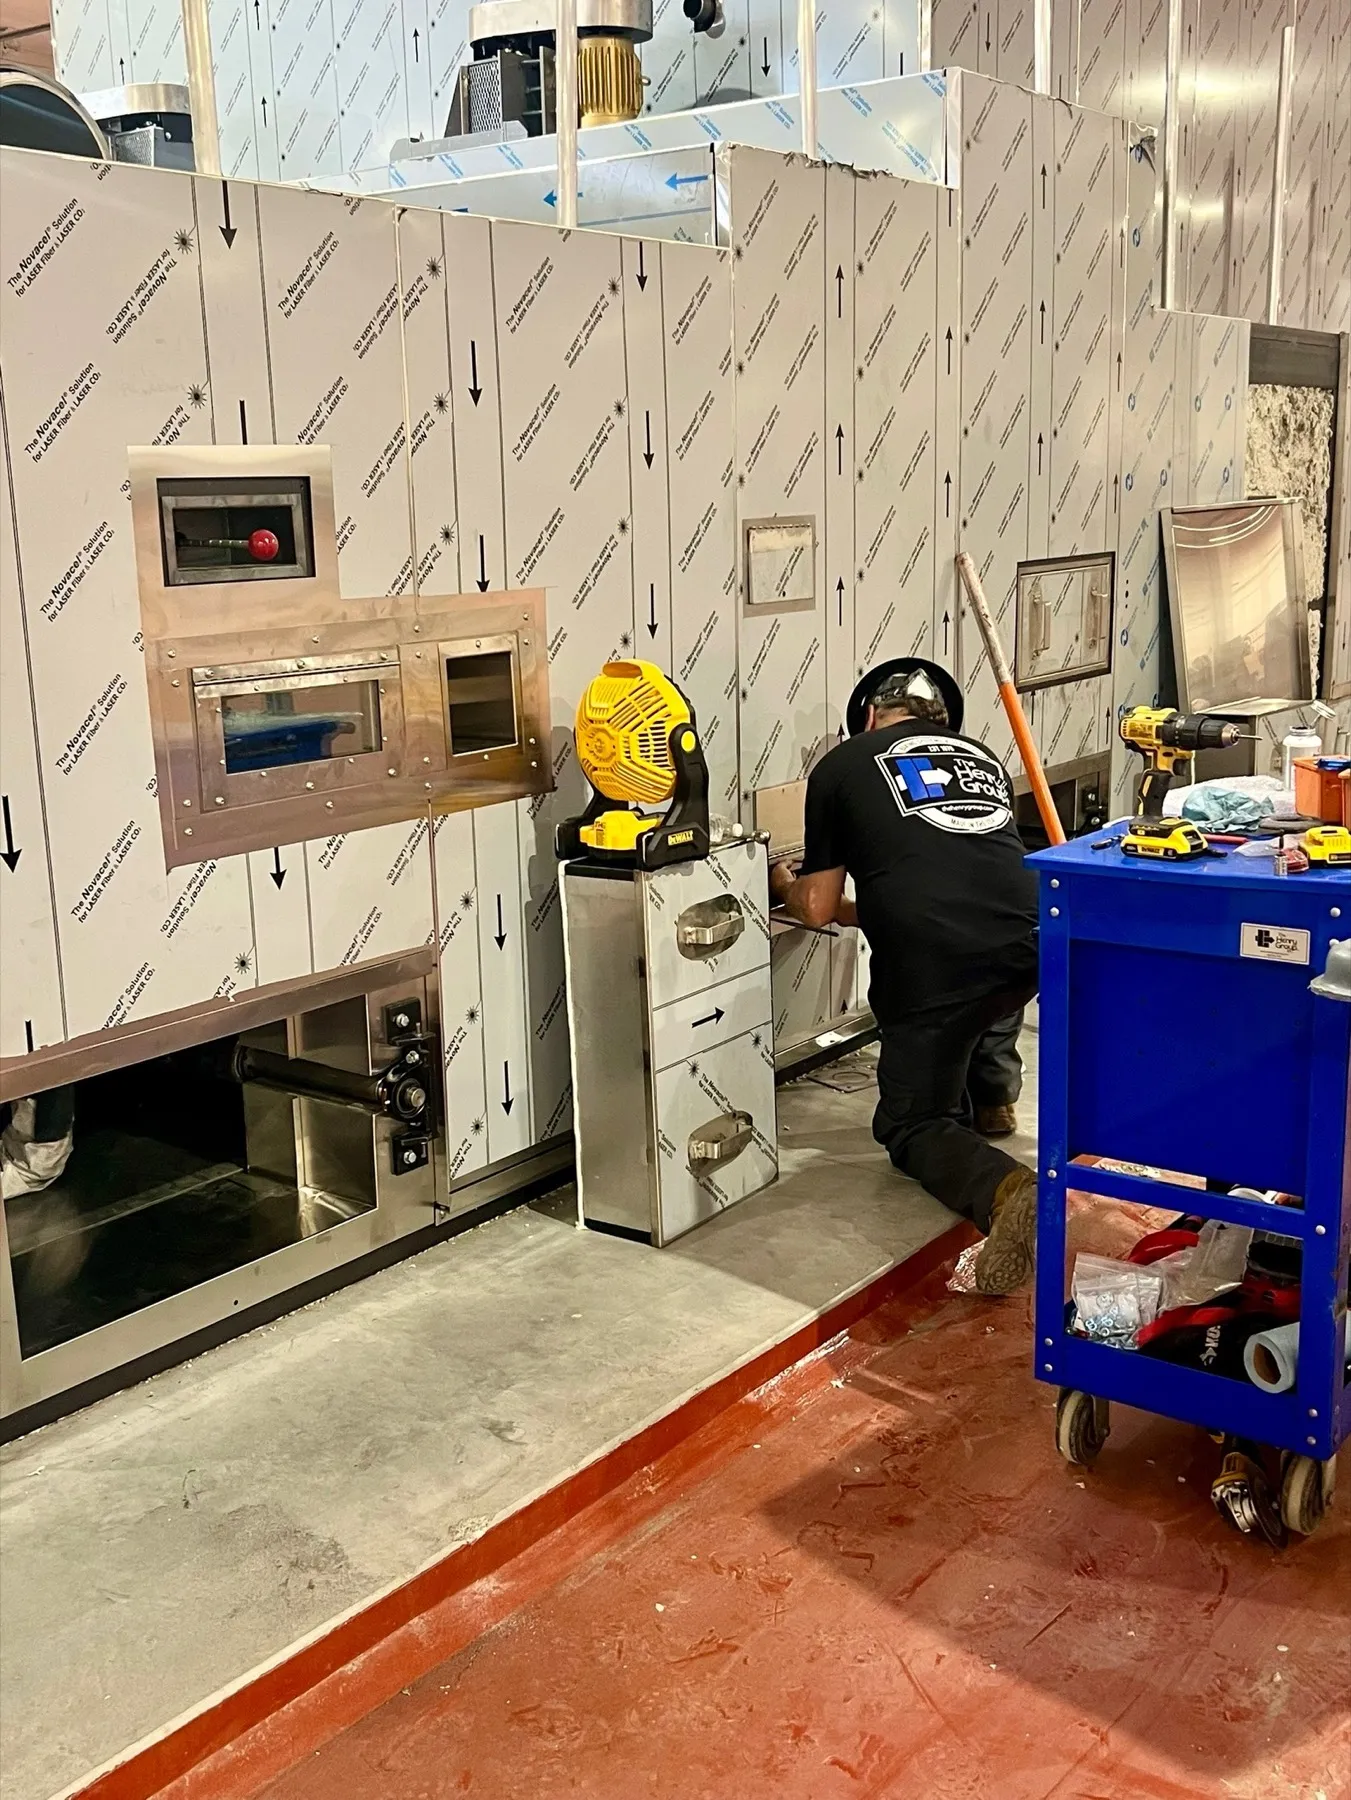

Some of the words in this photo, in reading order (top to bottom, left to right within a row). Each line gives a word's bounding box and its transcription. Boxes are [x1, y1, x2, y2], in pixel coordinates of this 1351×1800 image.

[7, 272, 22, 287] The
[51, 198, 78, 230] Solution
[161, 248, 170, 260] for
[15, 284, 25, 297] for
[23, 262, 43, 287] LASER
[40, 245, 55, 265] Fiber
[56, 219, 75, 243] LASER
[145, 258, 163, 281] LASER
[164, 257, 178, 272] The
[277, 296, 289, 310] The
[313, 231, 333, 259] Solution
[134, 279, 148, 297] Fiber
[283, 307, 292, 319] for
[290, 288, 306, 309] LASER
[303, 273, 315, 290] Fiber
[316, 250, 331, 271] LASER
[115, 300, 133, 323] LASER
[113, 313, 137, 343] Solution
[323, 376, 343, 404] Solution
[24, 438, 39, 453] The
[68, 362, 94, 394] Solution
[174, 404, 183, 416] for
[177, 413, 190, 427] The
[313, 418, 325, 435] Fiber
[326, 394, 341, 415] LASER
[32, 450, 42, 462] for
[39, 427, 59, 452] LASER
[56, 410, 71, 429] Fiber
[72, 383, 91, 407] LASER
[159, 414, 177, 437] LASER
[336, 515, 352, 540] olution
[39, 598, 54, 613] The
[82, 521, 107, 553] Solution
[47, 609, 57, 622] for
[54, 587, 74, 611] LASER
[71, 568, 86, 588] Fiber
[87, 541, 105, 565] LASER
[55, 752, 69, 767] The
[97, 673, 121, 706] Solution
[62, 763, 72, 775] for
[69, 740, 88, 764] LASER
[85, 721, 100, 741] Fiber
[101, 693, 119, 717] LASER
[953, 758, 976, 767] The
[70, 901, 84, 916] The
[111, 820, 135, 853] Solution
[317, 850, 328, 863] The
[323, 859, 331, 870] for
[329, 838, 343, 860] LASER
[78, 910, 87, 923] for
[85, 887, 103, 911] LASER
[100, 868, 114, 887] Fiber
[115, 840, 133, 864] LASER
[186, 873, 199, 892] Fiber
[169, 896, 185, 919] LASER
[358, 906, 377, 935] Solution
[167, 906, 189, 938] Solution
[349, 948, 360, 965] Fiber
[361, 923, 375, 944] LASER
[1275, 942, 1298, 951] Group
[1276, 936, 1298, 945] Henry
[124, 962, 149, 995] Solution
[222, 975, 230, 986] for
[224, 981, 236, 995] The
[128, 981, 146, 1005] LASER
